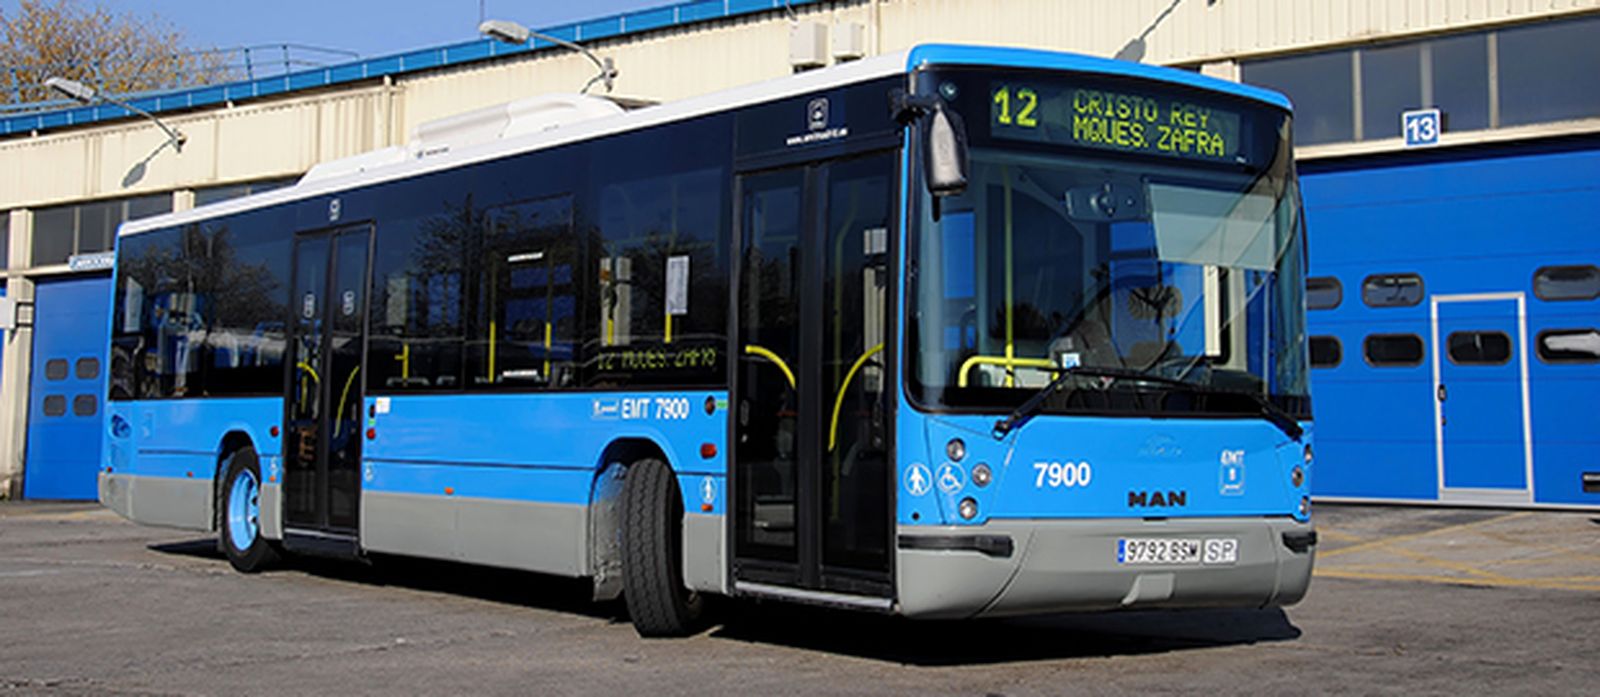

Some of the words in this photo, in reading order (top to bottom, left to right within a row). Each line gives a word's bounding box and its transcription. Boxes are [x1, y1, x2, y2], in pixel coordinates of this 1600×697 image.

[994, 86, 1037, 127] 12
[1073, 89, 1158, 122] CRISTO
[1170, 103, 1210, 128] REY
[1073, 115, 1149, 148] MQUES.
[1156, 125, 1224, 157] ZAFRA
[1408, 117, 1434, 141] 13
[621, 398, 651, 419] EMT
[655, 398, 690, 419] 7900
[1033, 461, 1091, 488] 7900
[1127, 491, 1187, 507] MAN
[1127, 541, 1167, 561] 9792
[1207, 541, 1235, 561] SP
